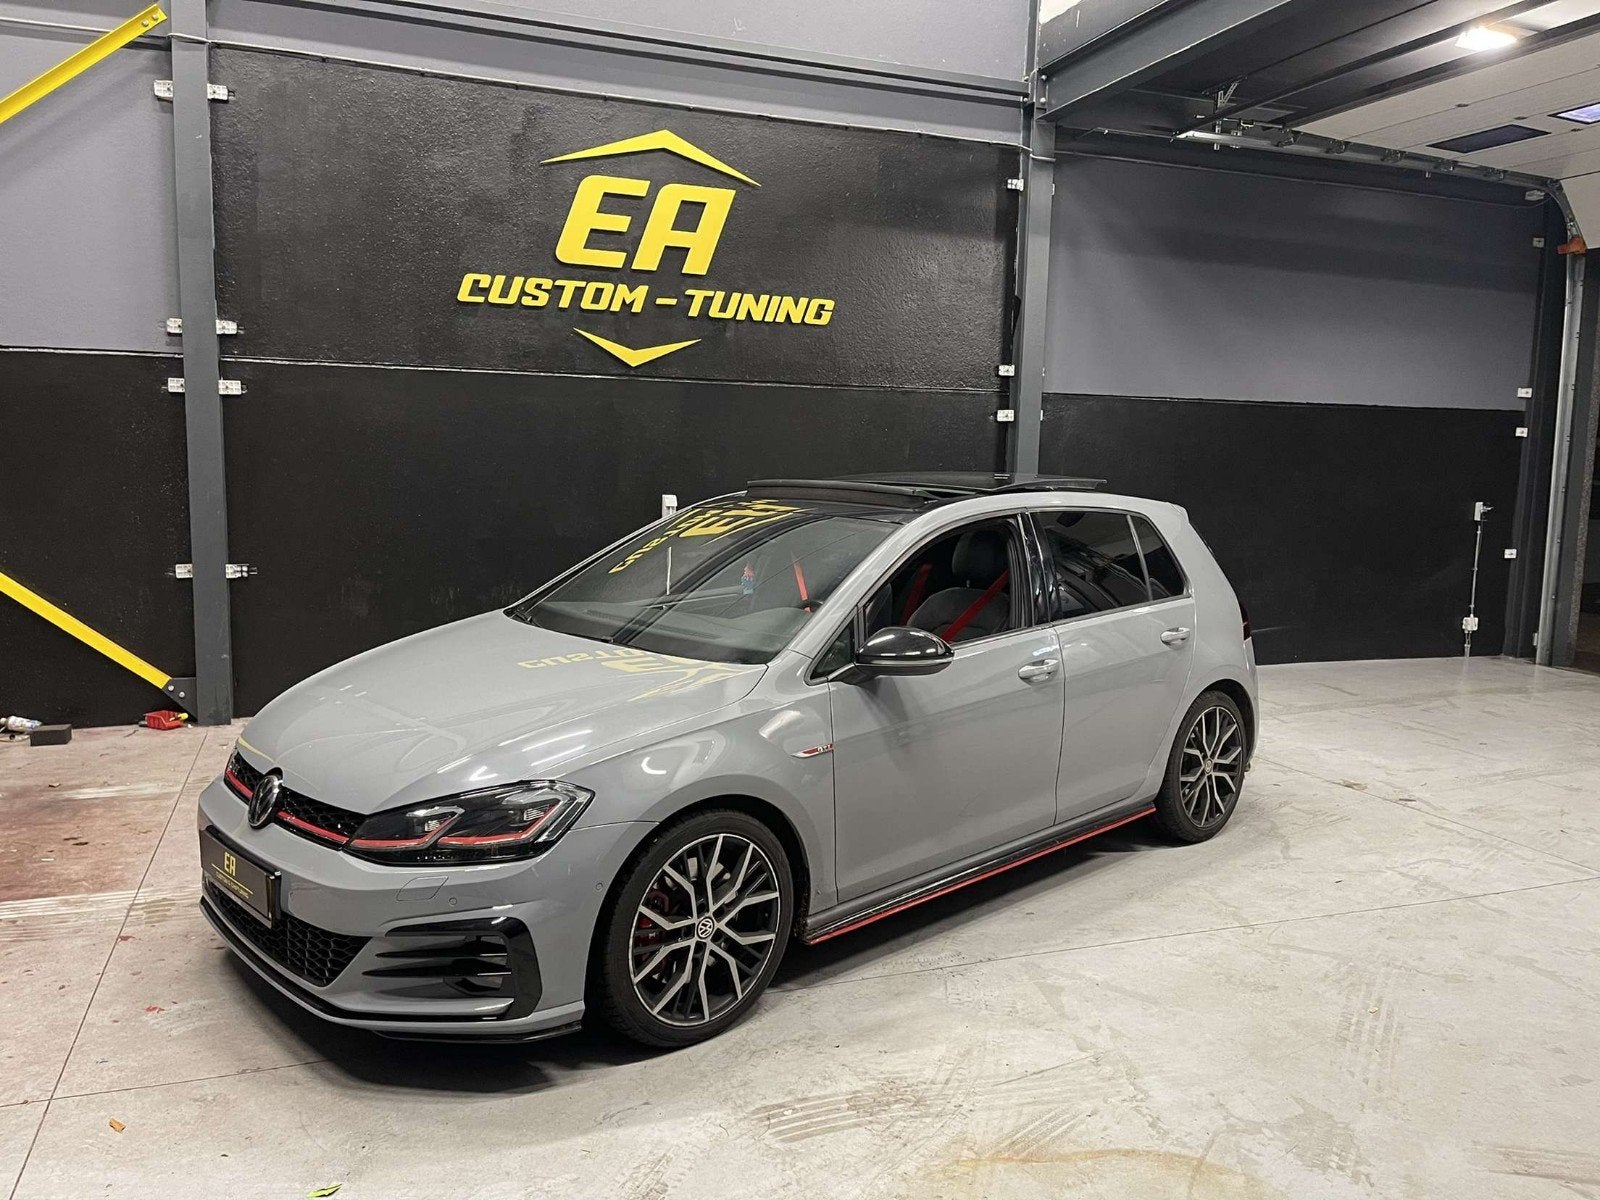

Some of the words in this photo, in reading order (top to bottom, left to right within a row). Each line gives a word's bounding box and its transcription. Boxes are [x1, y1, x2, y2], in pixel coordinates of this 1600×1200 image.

[555, 174, 737, 276] EA
[456, 273, 649, 314] CUSTOM
[684, 289, 836, 326] TUNING
[224, 851, 236, 877] EA
